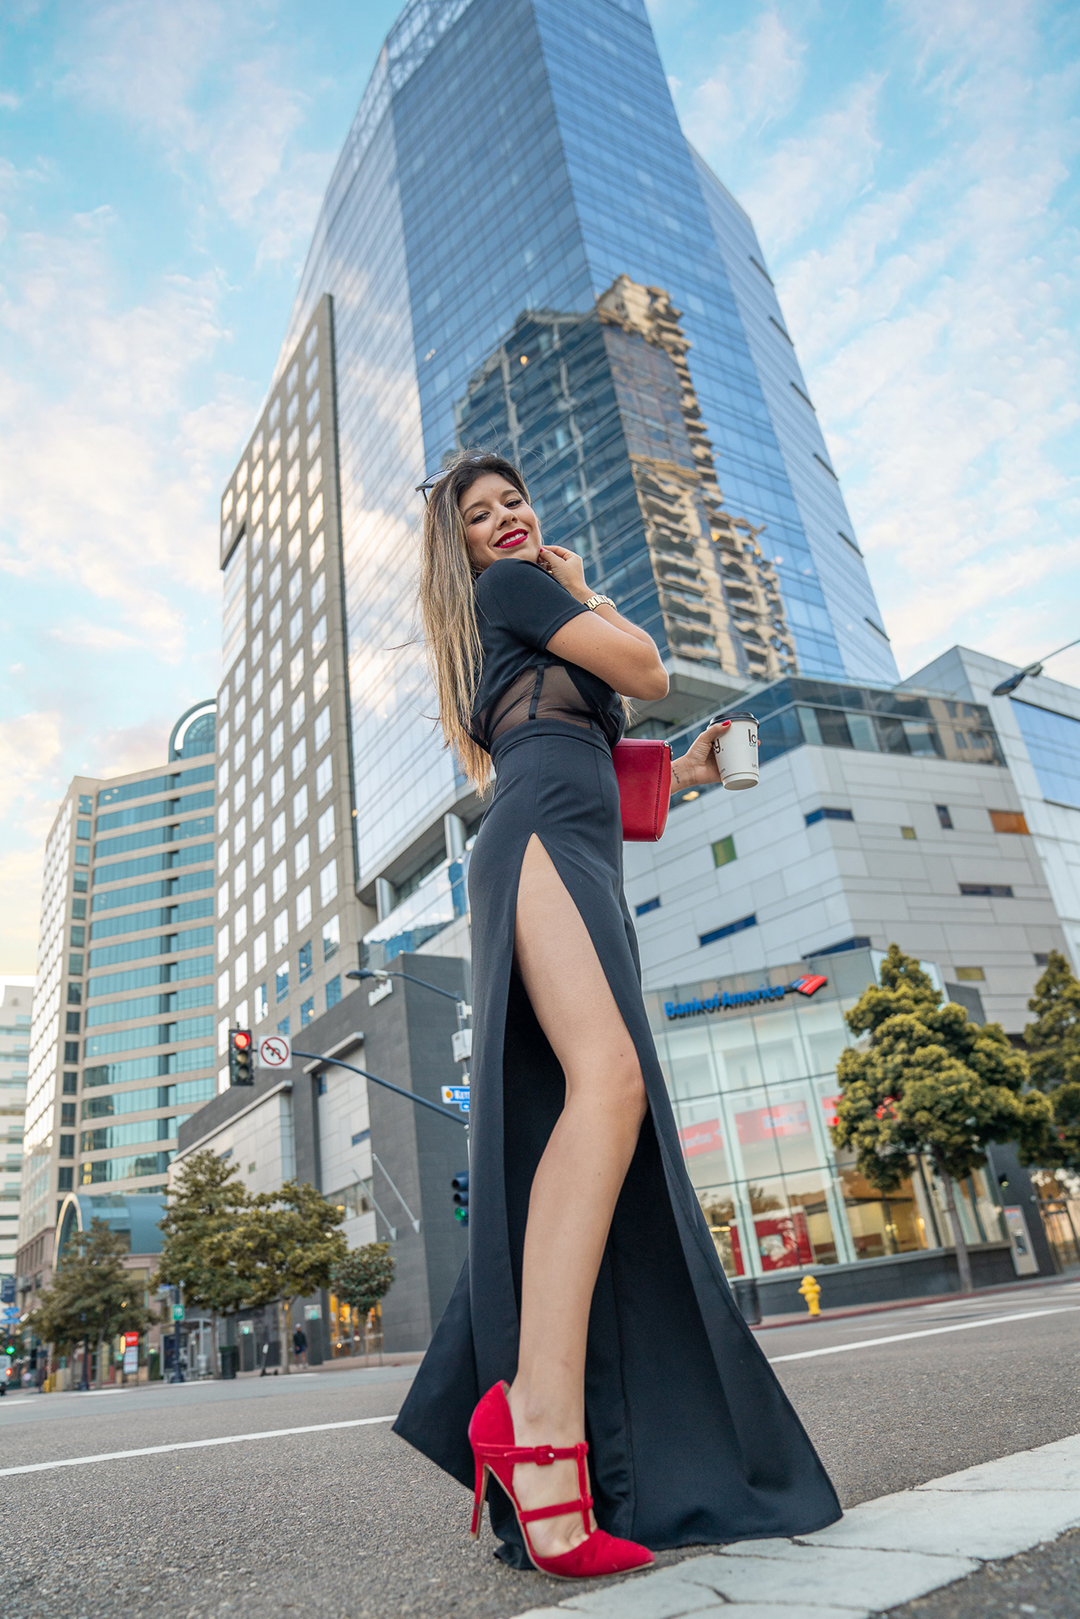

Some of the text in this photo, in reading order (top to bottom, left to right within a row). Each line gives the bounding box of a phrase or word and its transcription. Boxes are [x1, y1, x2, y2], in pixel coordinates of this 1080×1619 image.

[664, 984, 785, 1017] Bank of America
